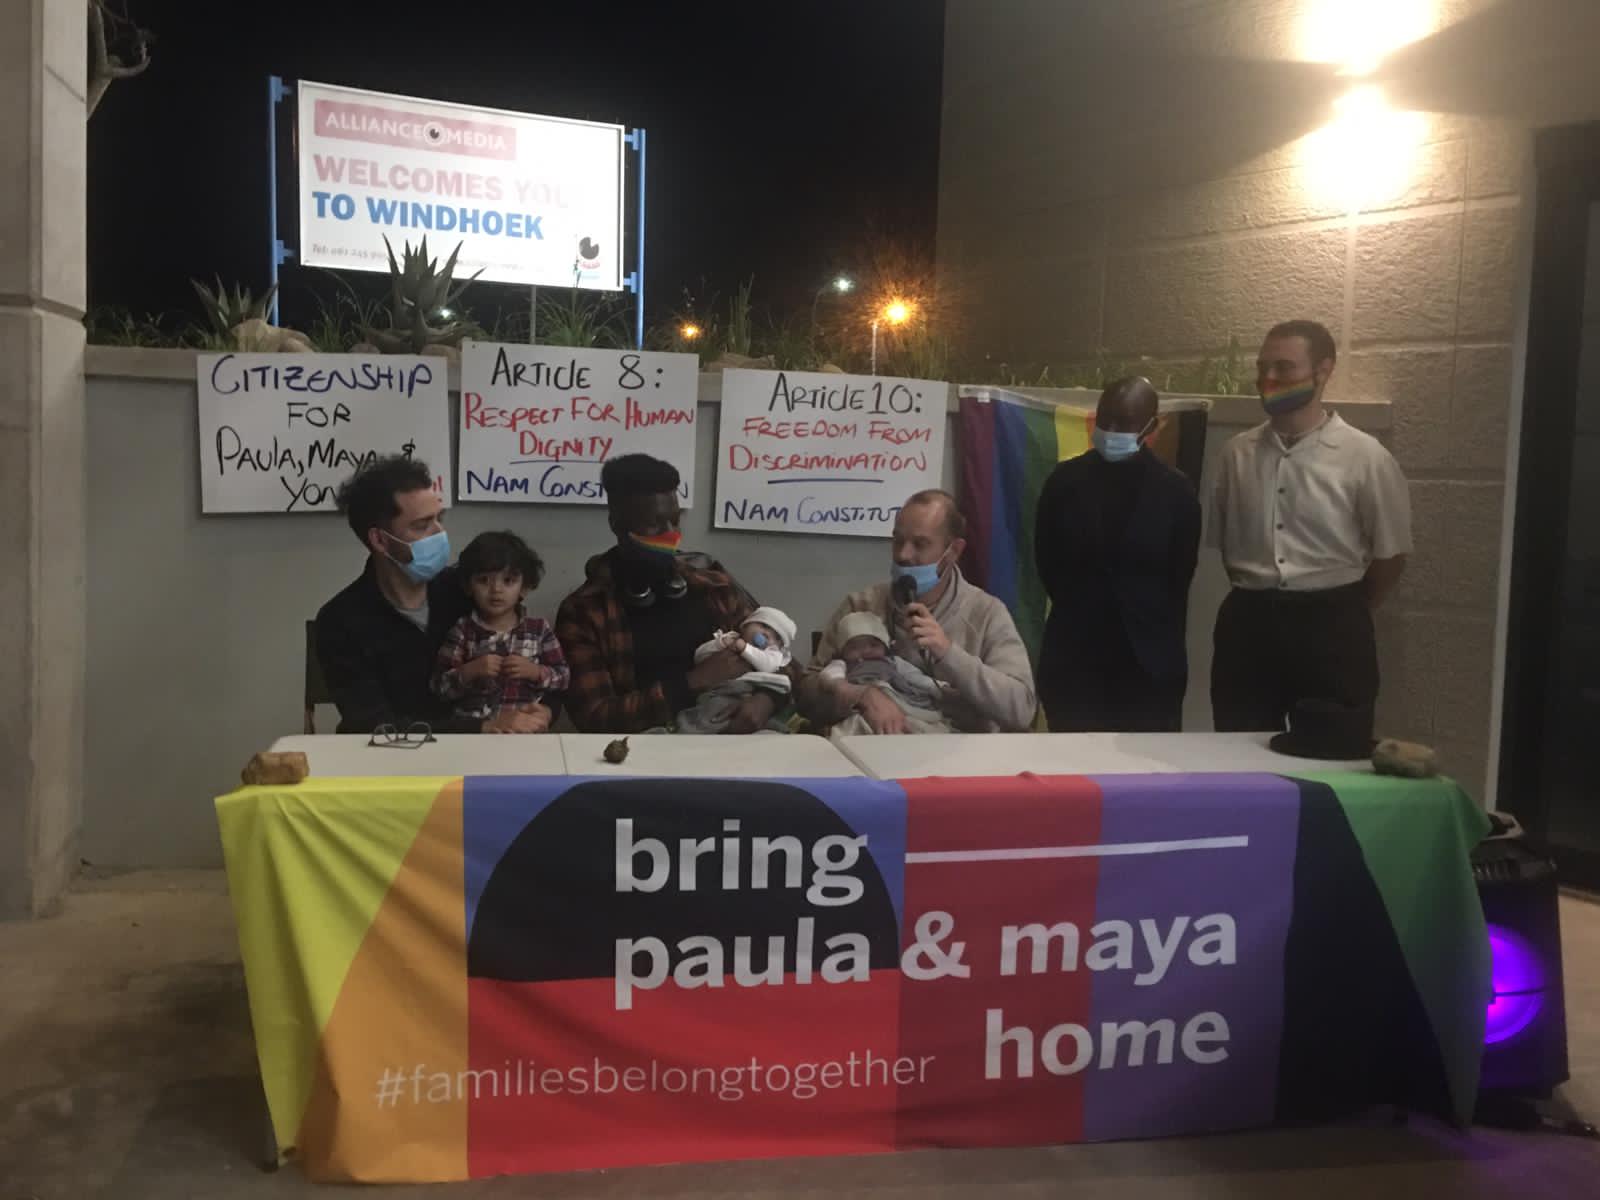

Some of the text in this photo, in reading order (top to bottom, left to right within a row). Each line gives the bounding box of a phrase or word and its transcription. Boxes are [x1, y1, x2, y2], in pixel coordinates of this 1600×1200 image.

[326, 111, 508, 151] ALLIANCE MEDIA
[313, 154, 504, 201] WELCOMES
[312, 191, 544, 240] TO WINDHOEK
[211, 354, 433, 398] CITIZENSHIP
[619, 354, 664, 390] 8:
[287, 402, 351, 428] FOR
[464, 392, 694, 432] RESPECT FOR HUMAN
[742, 416, 931, 445] FREEDOM FROM
[519, 430, 613, 463] DIGNITY
[467, 467, 529, 495] NAM
[724, 499, 788, 524] NAM
[615, 818, 868, 907] bring
[615, 910, 1238, 1010] paula & maya
[985, 1008, 1231, 1080] home
[374, 1049, 936, 1109] #familiesbelongtogether
